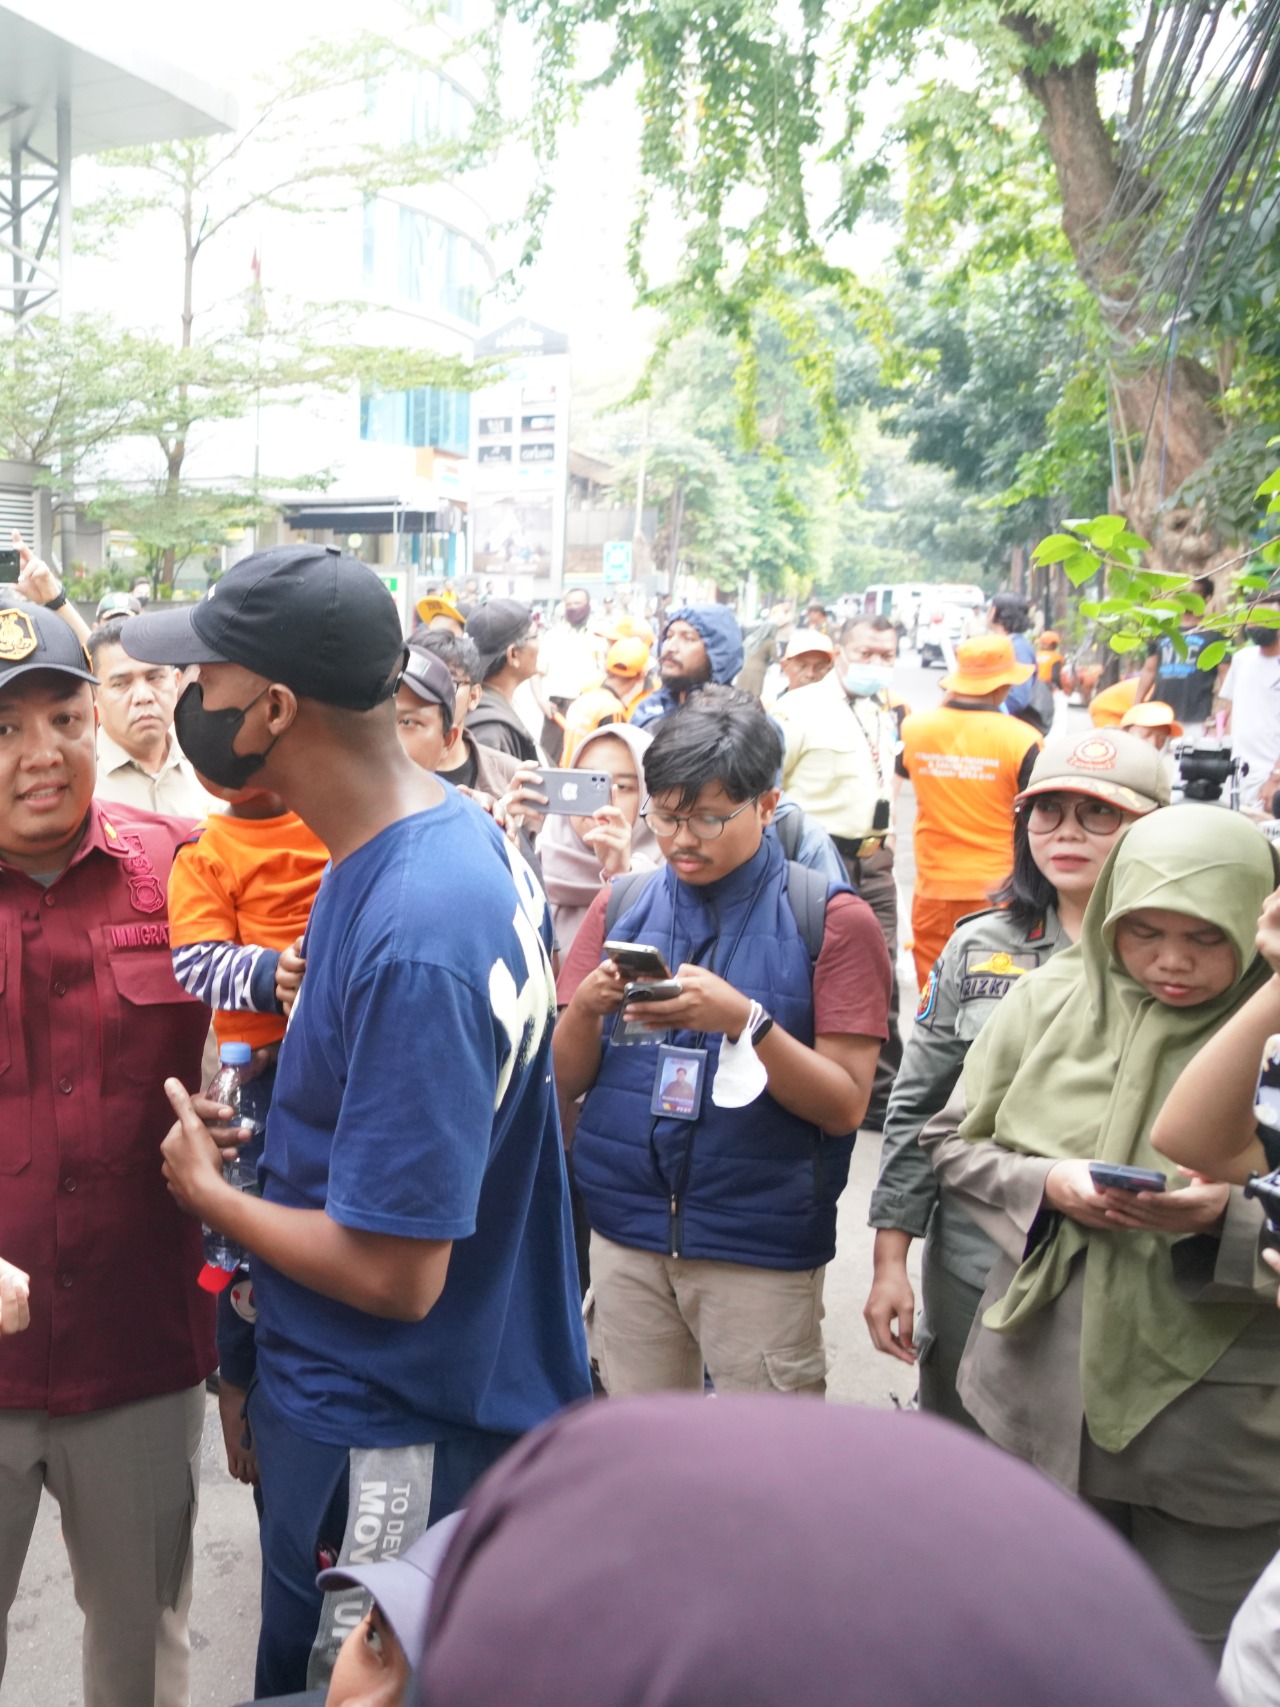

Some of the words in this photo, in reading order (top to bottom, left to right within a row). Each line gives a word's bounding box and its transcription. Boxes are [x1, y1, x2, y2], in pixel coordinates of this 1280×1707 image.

[391, 1482, 411, 1514] TO
[350, 1480, 387, 1565] MOV
[381, 1519, 405, 1563] DEV
